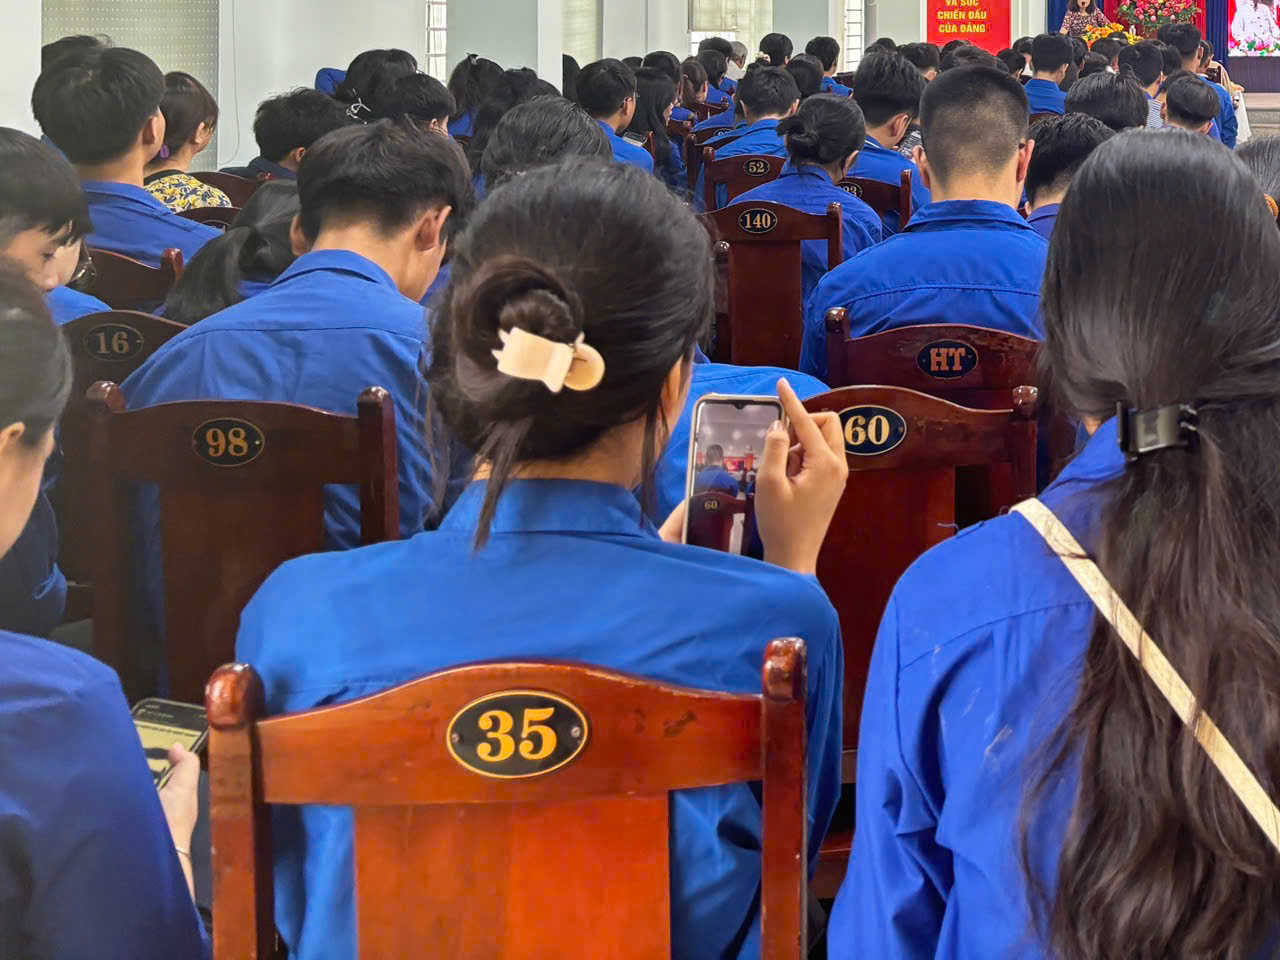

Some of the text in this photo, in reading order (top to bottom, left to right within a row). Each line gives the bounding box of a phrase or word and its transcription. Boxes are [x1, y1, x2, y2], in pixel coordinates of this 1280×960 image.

[749, 161, 764, 172] 52
[745, 213, 771, 229] 140
[96, 331, 129, 354] 16
[929, 347, 967, 371] HT
[844, 415, 890, 445] 60
[206, 428, 248, 457] 98
[704, 500, 718, 509] 60
[476, 707, 556, 762] 35
